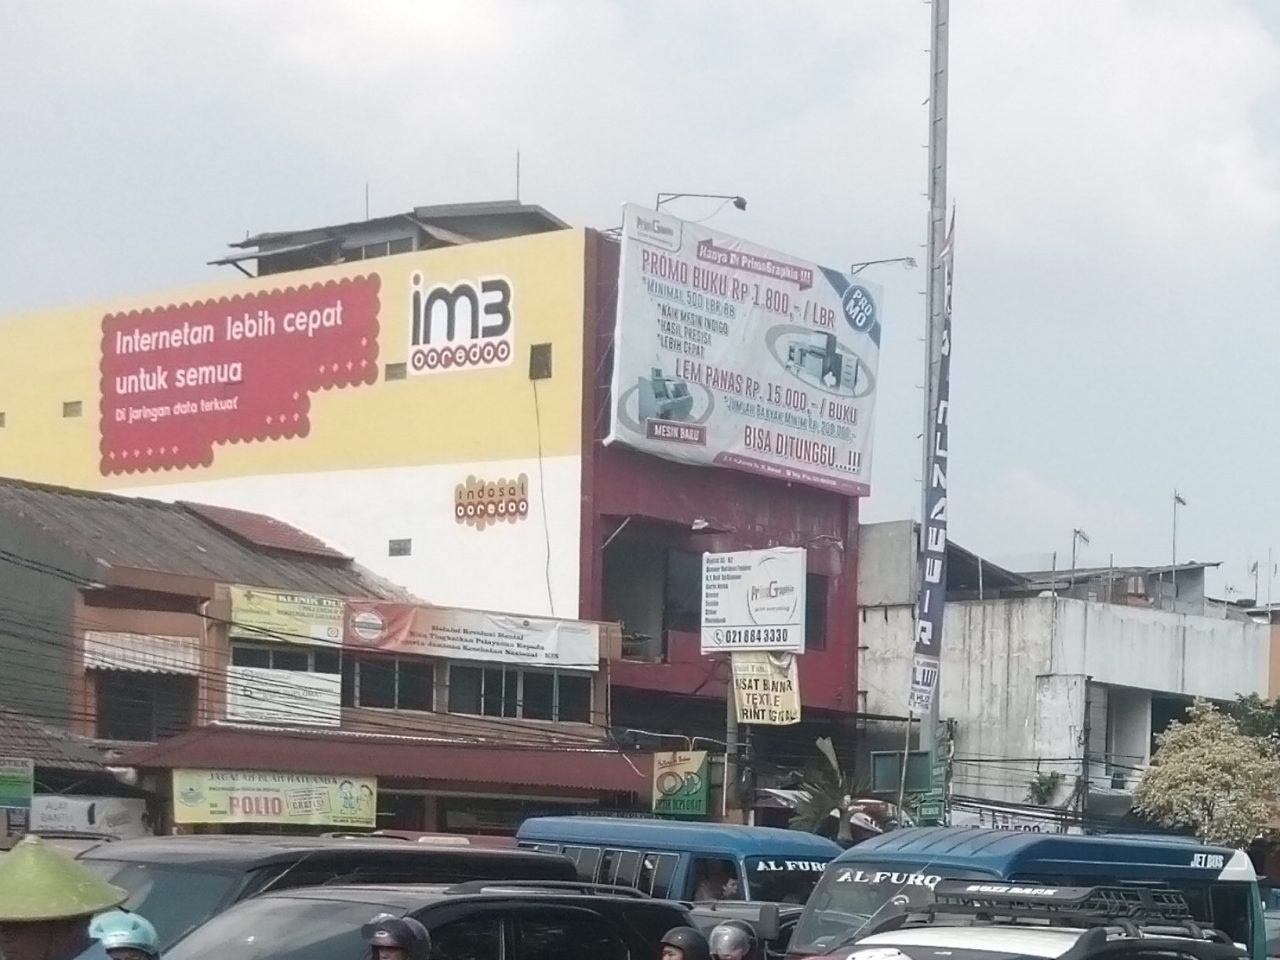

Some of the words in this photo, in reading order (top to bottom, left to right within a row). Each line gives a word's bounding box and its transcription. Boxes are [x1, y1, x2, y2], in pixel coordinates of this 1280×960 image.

[700, 245, 728, 264] Hanya
[729, 252, 739, 266] Di
[642, 249, 688, 284] PROMO
[693, 266, 727, 296] BUKU
[813, 302, 835, 329] LBR
[647, 280, 683, 302] MINIMAL
[411, 273, 511, 346] im3
[845, 299, 867, 327] MO
[853, 289, 873, 317] PRO
[115, 322, 214, 354] Internetan
[226, 310, 276, 340] lebih
[283, 299, 343, 337] cepat
[413, 341, 510, 369] ooredoo
[661, 335, 682, 352] LEBIH
[684, 341, 705, 358] CEPAT
[115, 365, 168, 394] untuk
[175, 361, 243, 388] semua
[675, 357, 702, 382] LEM
[706, 365, 743, 393] PANAS
[828, 401, 858, 425] BUKU
[115, 408, 126, 422] Di
[128, 404, 171, 424] jaringan
[173, 401, 198, 416] data
[200, 396, 240, 413] terkuat
[654, 424, 679, 438] MESIN
[680, 427, 700, 441] BARU
[745, 424, 772, 452] BISA
[458, 482, 525, 500] indosat
[457, 499, 527, 517] ooredoo
[725, 629, 742, 643] 021
[744, 629, 761, 643] 884
[763, 628, 788, 642] 3330
[229, 796, 282, 815] POLIO
[757, 861, 784, 872] AL
[1190, 853, 1207, 868] JET
[1206, 854, 1224, 868] BUS
[836, 871, 870, 883] AL
[872, 872, 942, 891] FURQ
